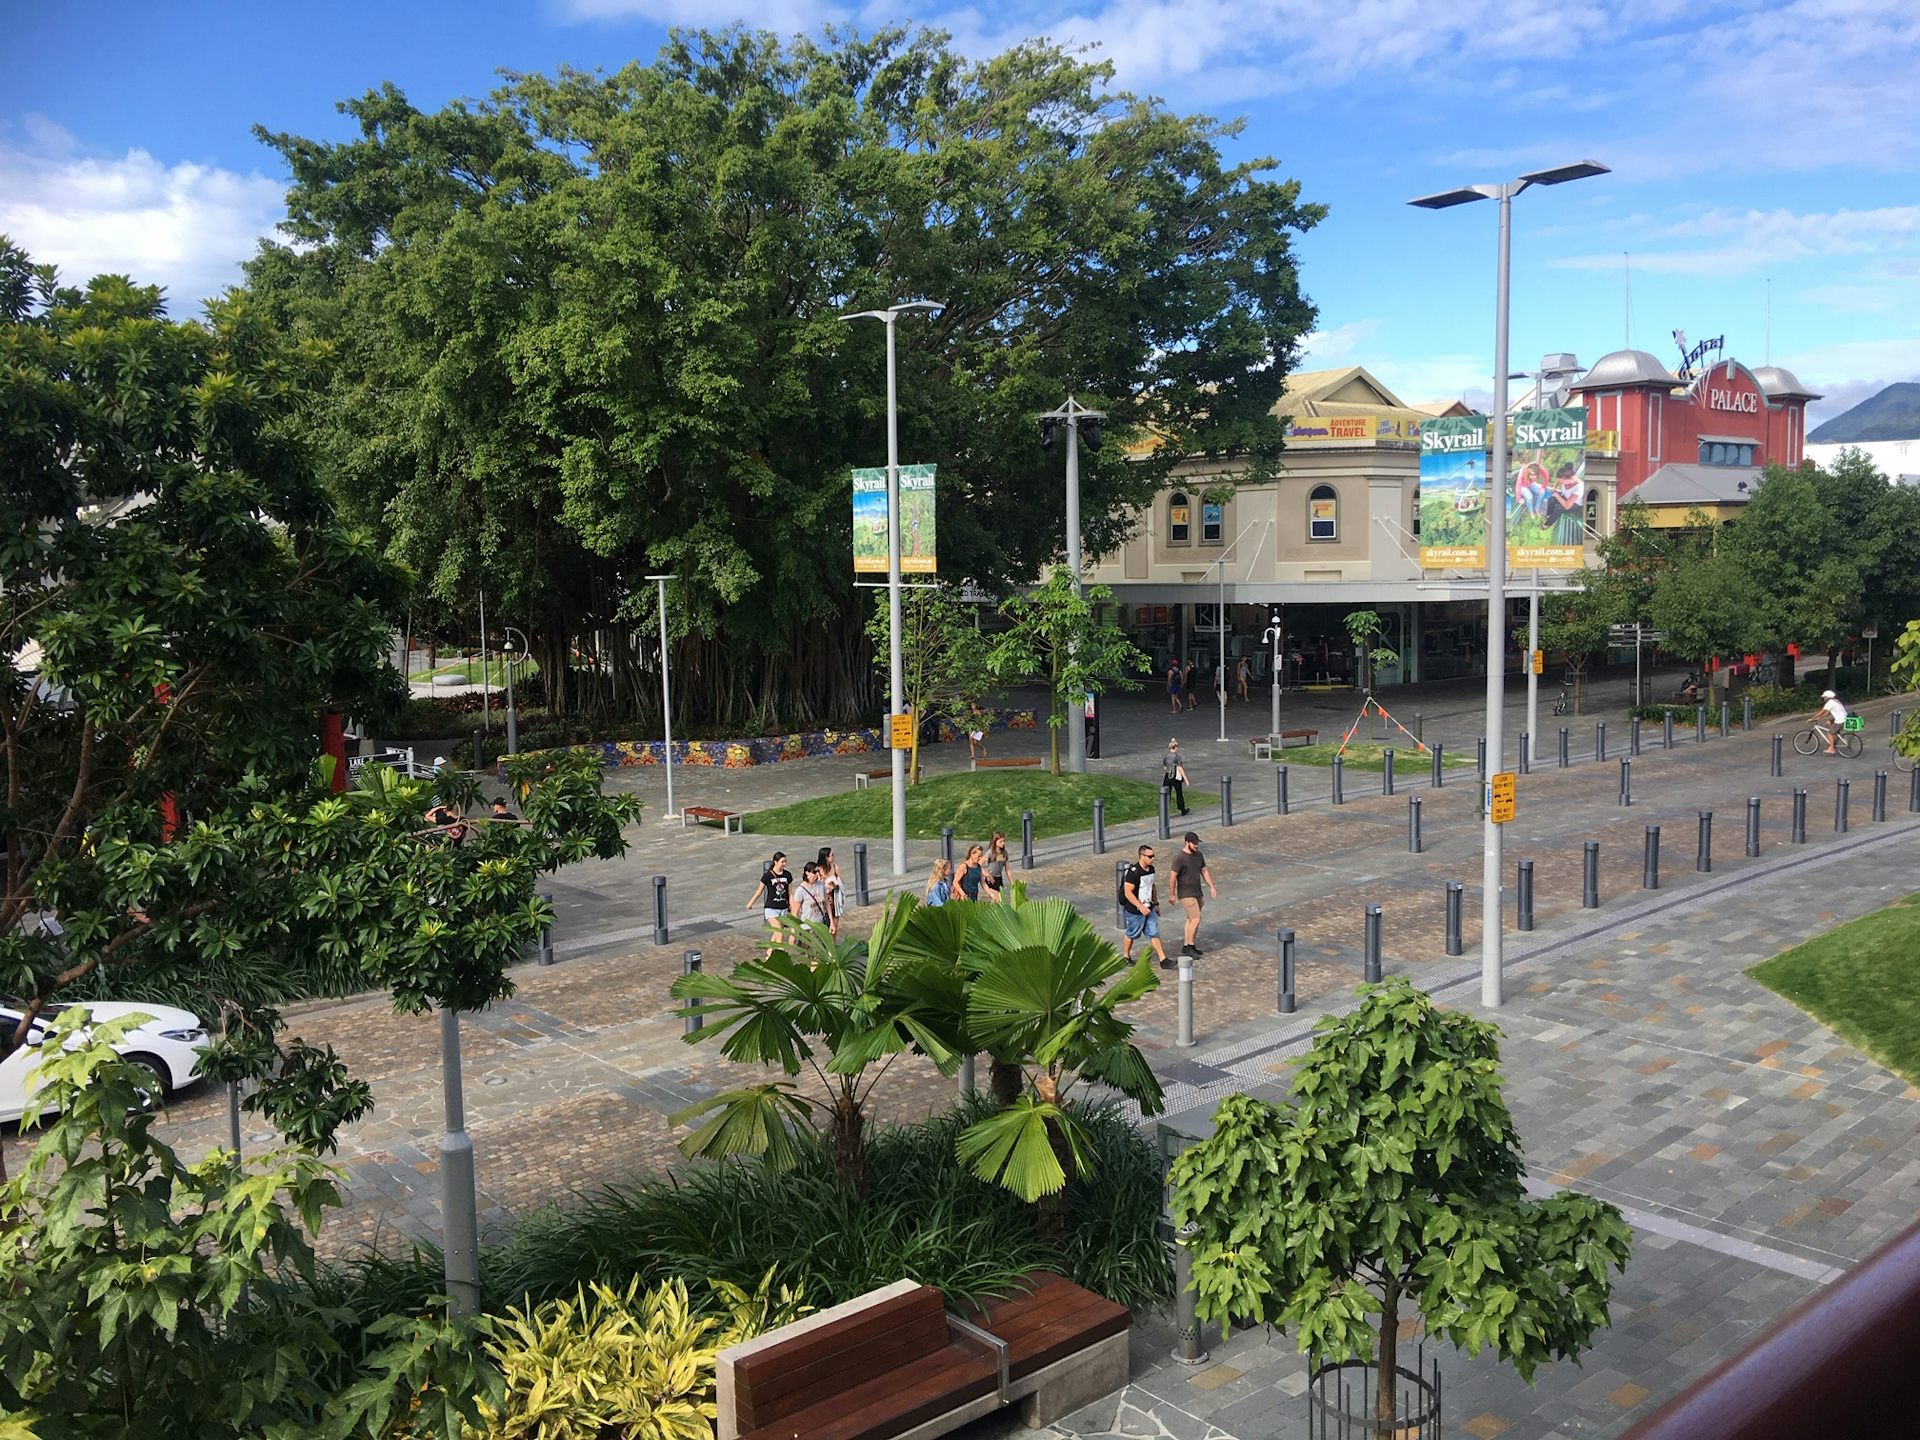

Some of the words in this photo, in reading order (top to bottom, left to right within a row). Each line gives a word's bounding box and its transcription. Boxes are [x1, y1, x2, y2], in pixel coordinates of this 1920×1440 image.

[1710, 388, 1758, 413] PALACE
[1330, 419, 1366, 427] ADVENTURE
[1330, 427, 1366, 438] TRAVEL
[1516, 421, 1583, 447] Skyrail
[1423, 428, 1483, 453] Skyrail
[853, 476, 886, 492] Skyrail
[900, 473, 935, 490] Skyrail
[1426, 548, 1478, 558] skyrail.com.au
[1517, 548, 1575, 558] skyrail.com.au
[349, 758, 365, 768] LAKE
